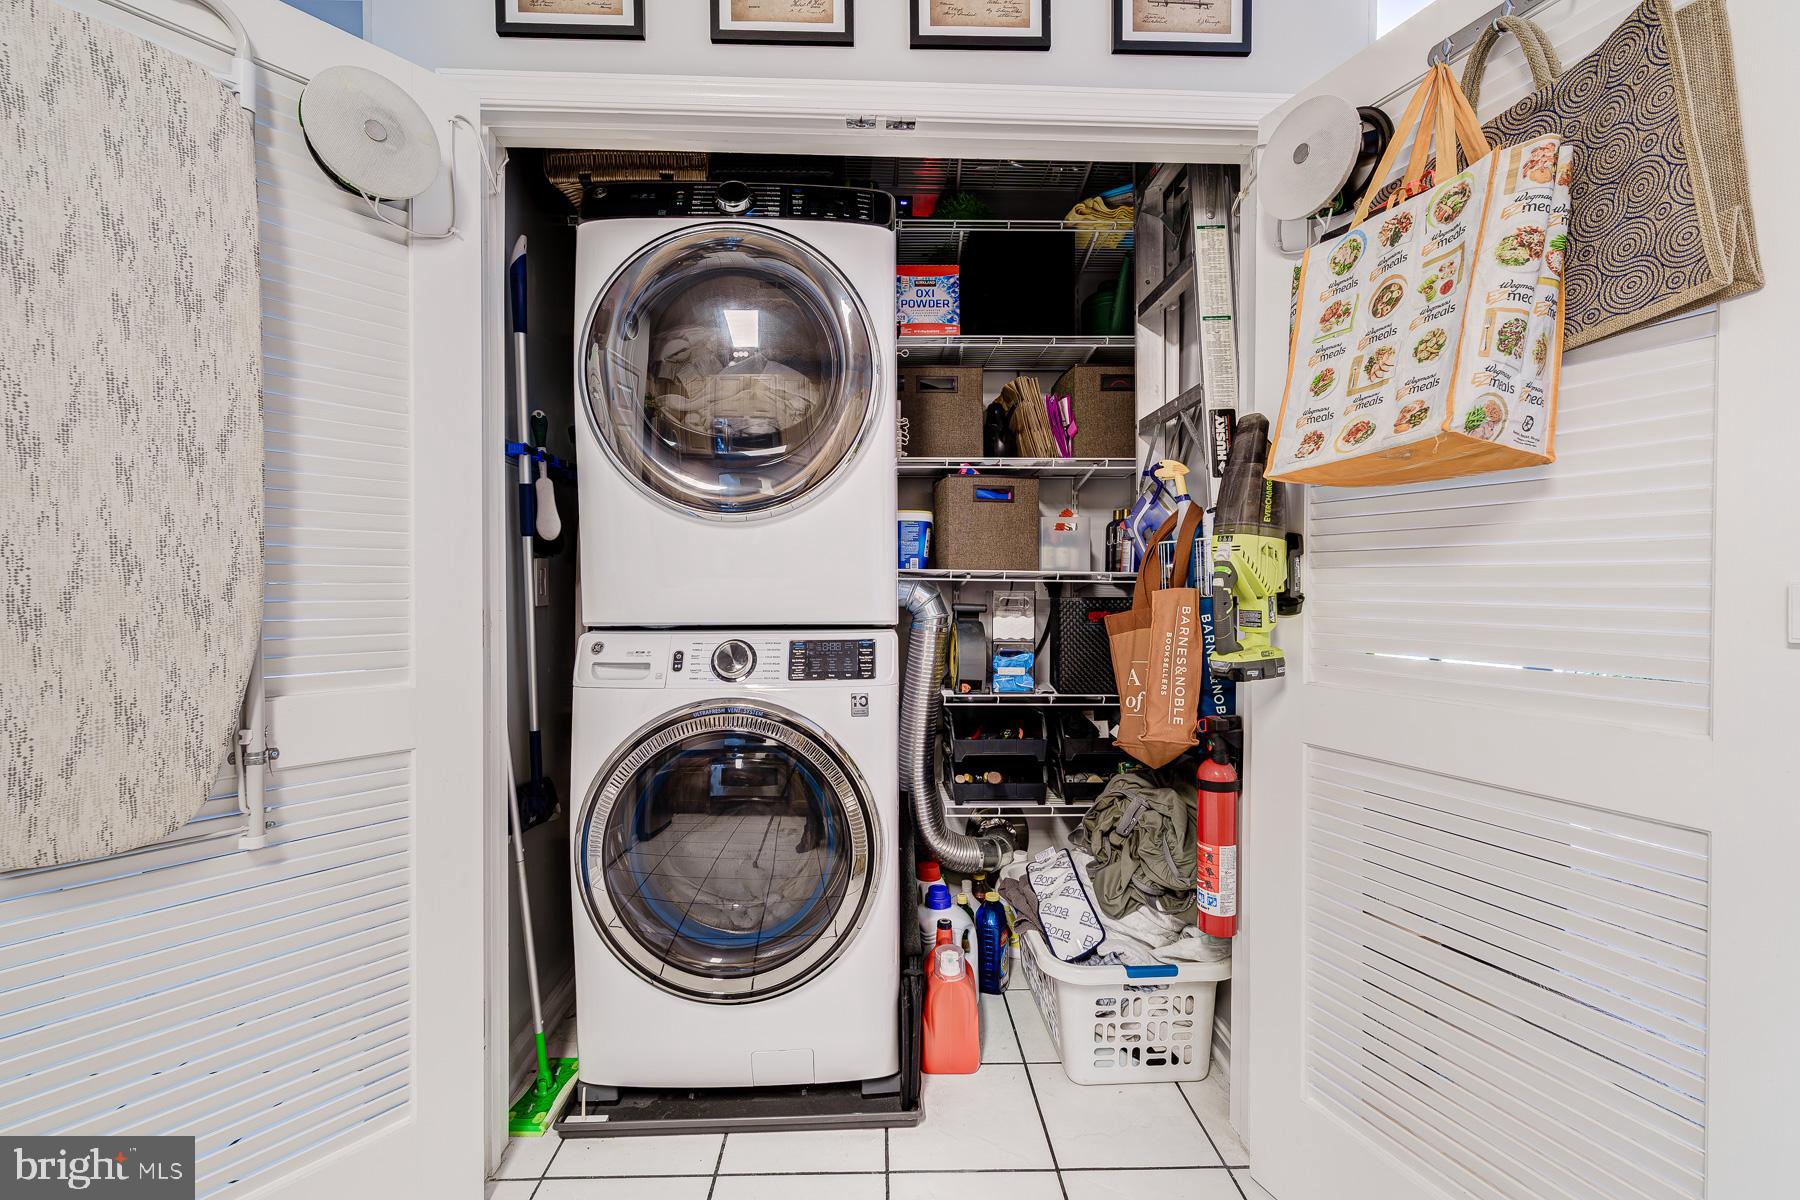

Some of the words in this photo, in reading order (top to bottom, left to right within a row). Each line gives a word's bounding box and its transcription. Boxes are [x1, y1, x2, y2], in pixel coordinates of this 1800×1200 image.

[1514, 192, 1553, 203] Wegman
[1437, 226, 1467, 249] meals
[1381, 253, 1408, 274] meals
[915, 289, 935, 298] OXI
[1332, 280, 1359, 296] meals
[1500, 280, 1535, 291] Wegman
[900, 299, 950, 308] POWDER
[1423, 303, 1456, 323] meals
[1368, 327, 1397, 345] meals
[1320, 346, 1347, 362] meals
[1408, 377, 1441, 395] meals
[1355, 396, 1384, 411] meals
[1306, 411, 1335, 425] meals
[1215, 415, 1227, 460] HUSKY
[1263, 479, 1273, 523] EVERCHARG
[1160, 632, 1173, 696] BOOKSELLERS
[1127, 668, 1141, 686] A
[1125, 691, 1146, 713] of
[692, 707, 726, 718] ULTRAFRESH
[1041, 902, 1069, 916] Bona
